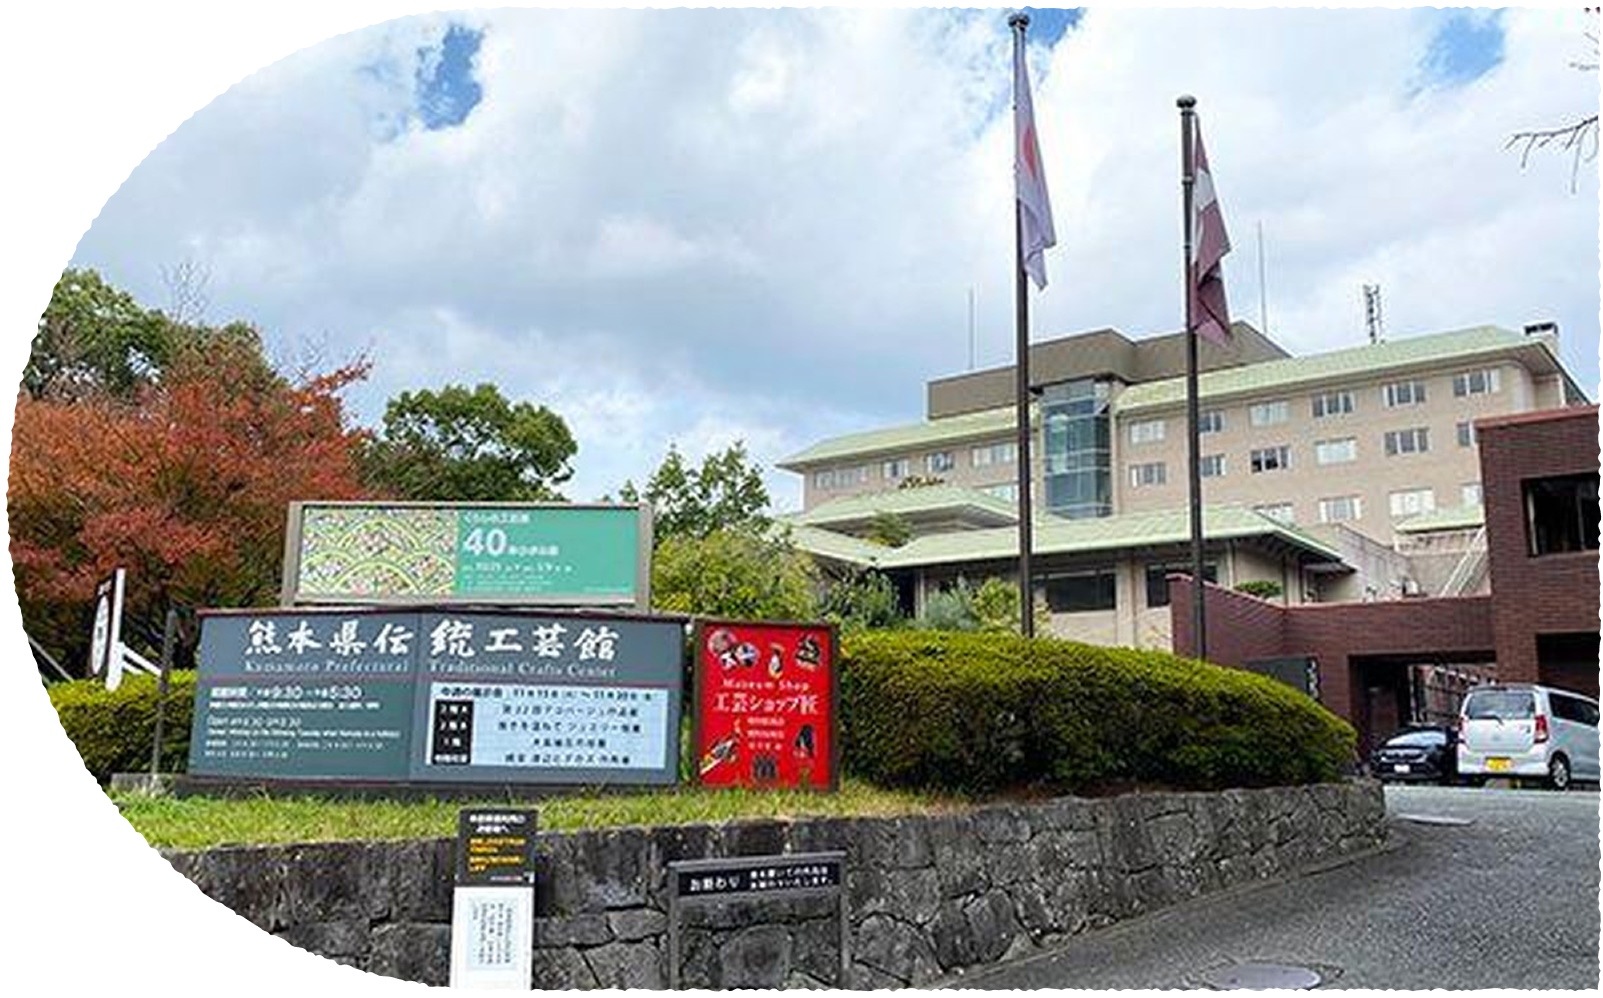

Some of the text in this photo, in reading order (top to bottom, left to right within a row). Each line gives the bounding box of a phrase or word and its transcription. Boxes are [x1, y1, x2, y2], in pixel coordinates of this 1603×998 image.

[463, 528, 507, 556] 40
[245, 618, 620, 660] 熊本県伝統工芸館
[430, 661, 511, 674] Traditional
[517, 663, 562, 675] Crafts
[567, 664, 617, 677] Center
[778, 680, 810, 692] Shop
